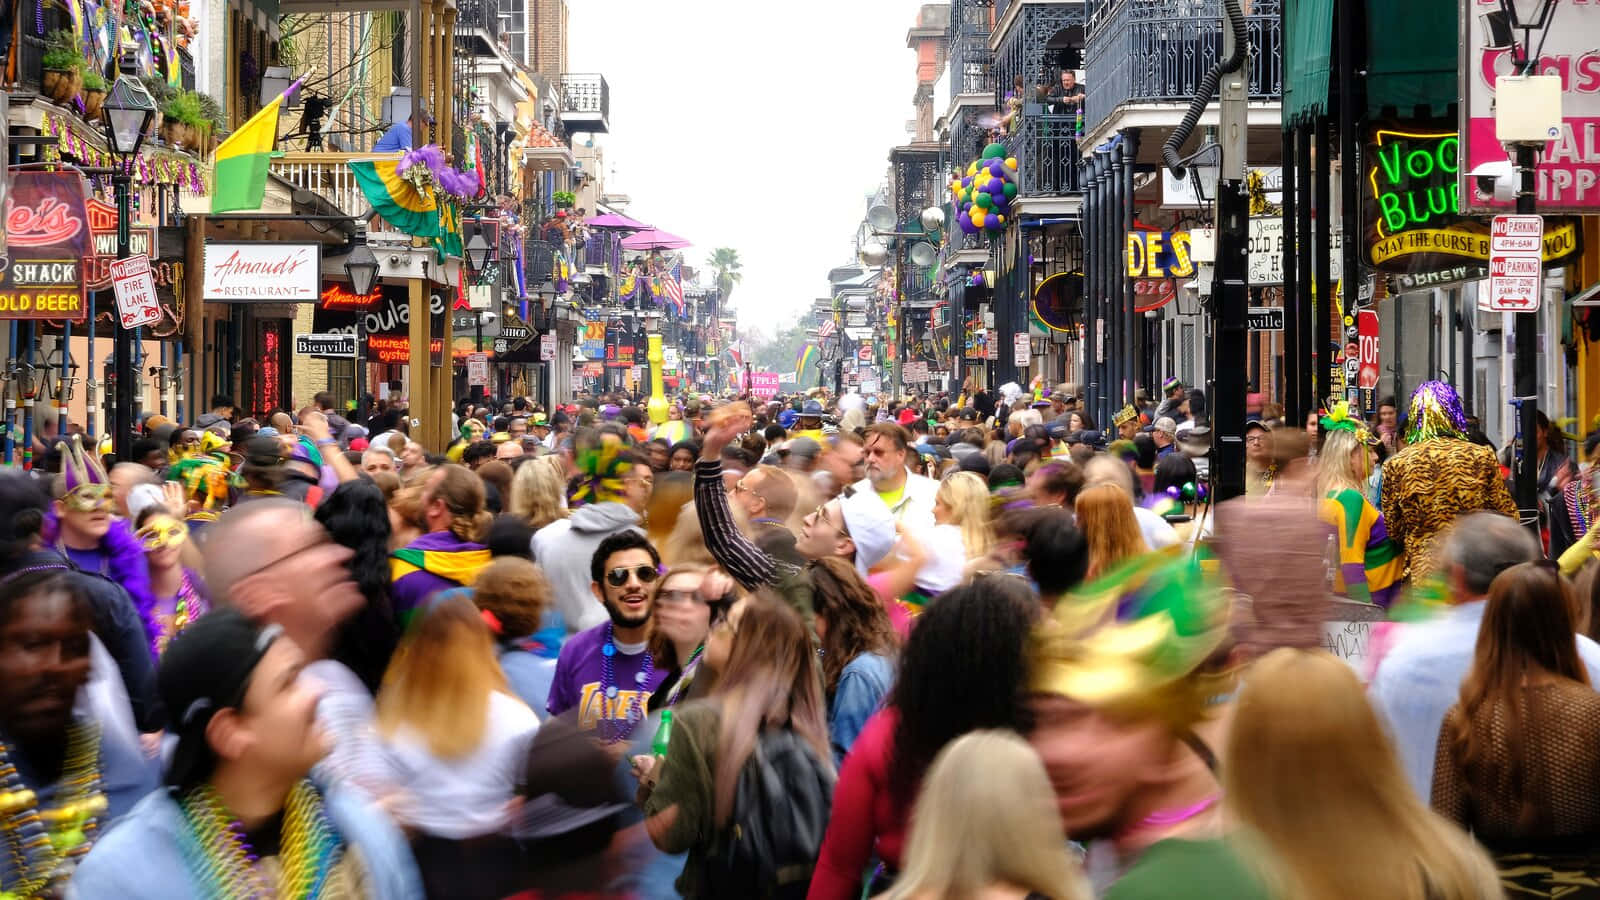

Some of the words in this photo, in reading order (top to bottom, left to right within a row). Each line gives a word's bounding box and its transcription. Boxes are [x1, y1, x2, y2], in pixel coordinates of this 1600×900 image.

[1379, 138, 1458, 183] VOO
[1538, 168, 1597, 201] IPP
[1380, 184, 1458, 232] BLUE
[1494, 221, 1506, 234] NO
[1508, 222, 1538, 233] PARKING
[1377, 237, 1404, 259] MAY
[1408, 233, 1430, 247] THE
[1433, 233, 1475, 253] CURSE
[1543, 229, 1573, 256] YOU
[13, 263, 75, 283] SHACK
[112, 263, 126, 280] NO
[214, 248, 308, 285] Arnaud's
[1492, 261, 1504, 273] NO
[1507, 261, 1537, 273] PARKING
[123, 278, 145, 293] FIRE
[224, 286, 299, 296] RESTAURANT
[0, 294, 30, 311] OLD
[36, 294, 79, 311] BEER
[125, 292, 149, 307] LANE
[298, 341, 354, 353] Bienville
[1358, 335, 1379, 364] TOP
